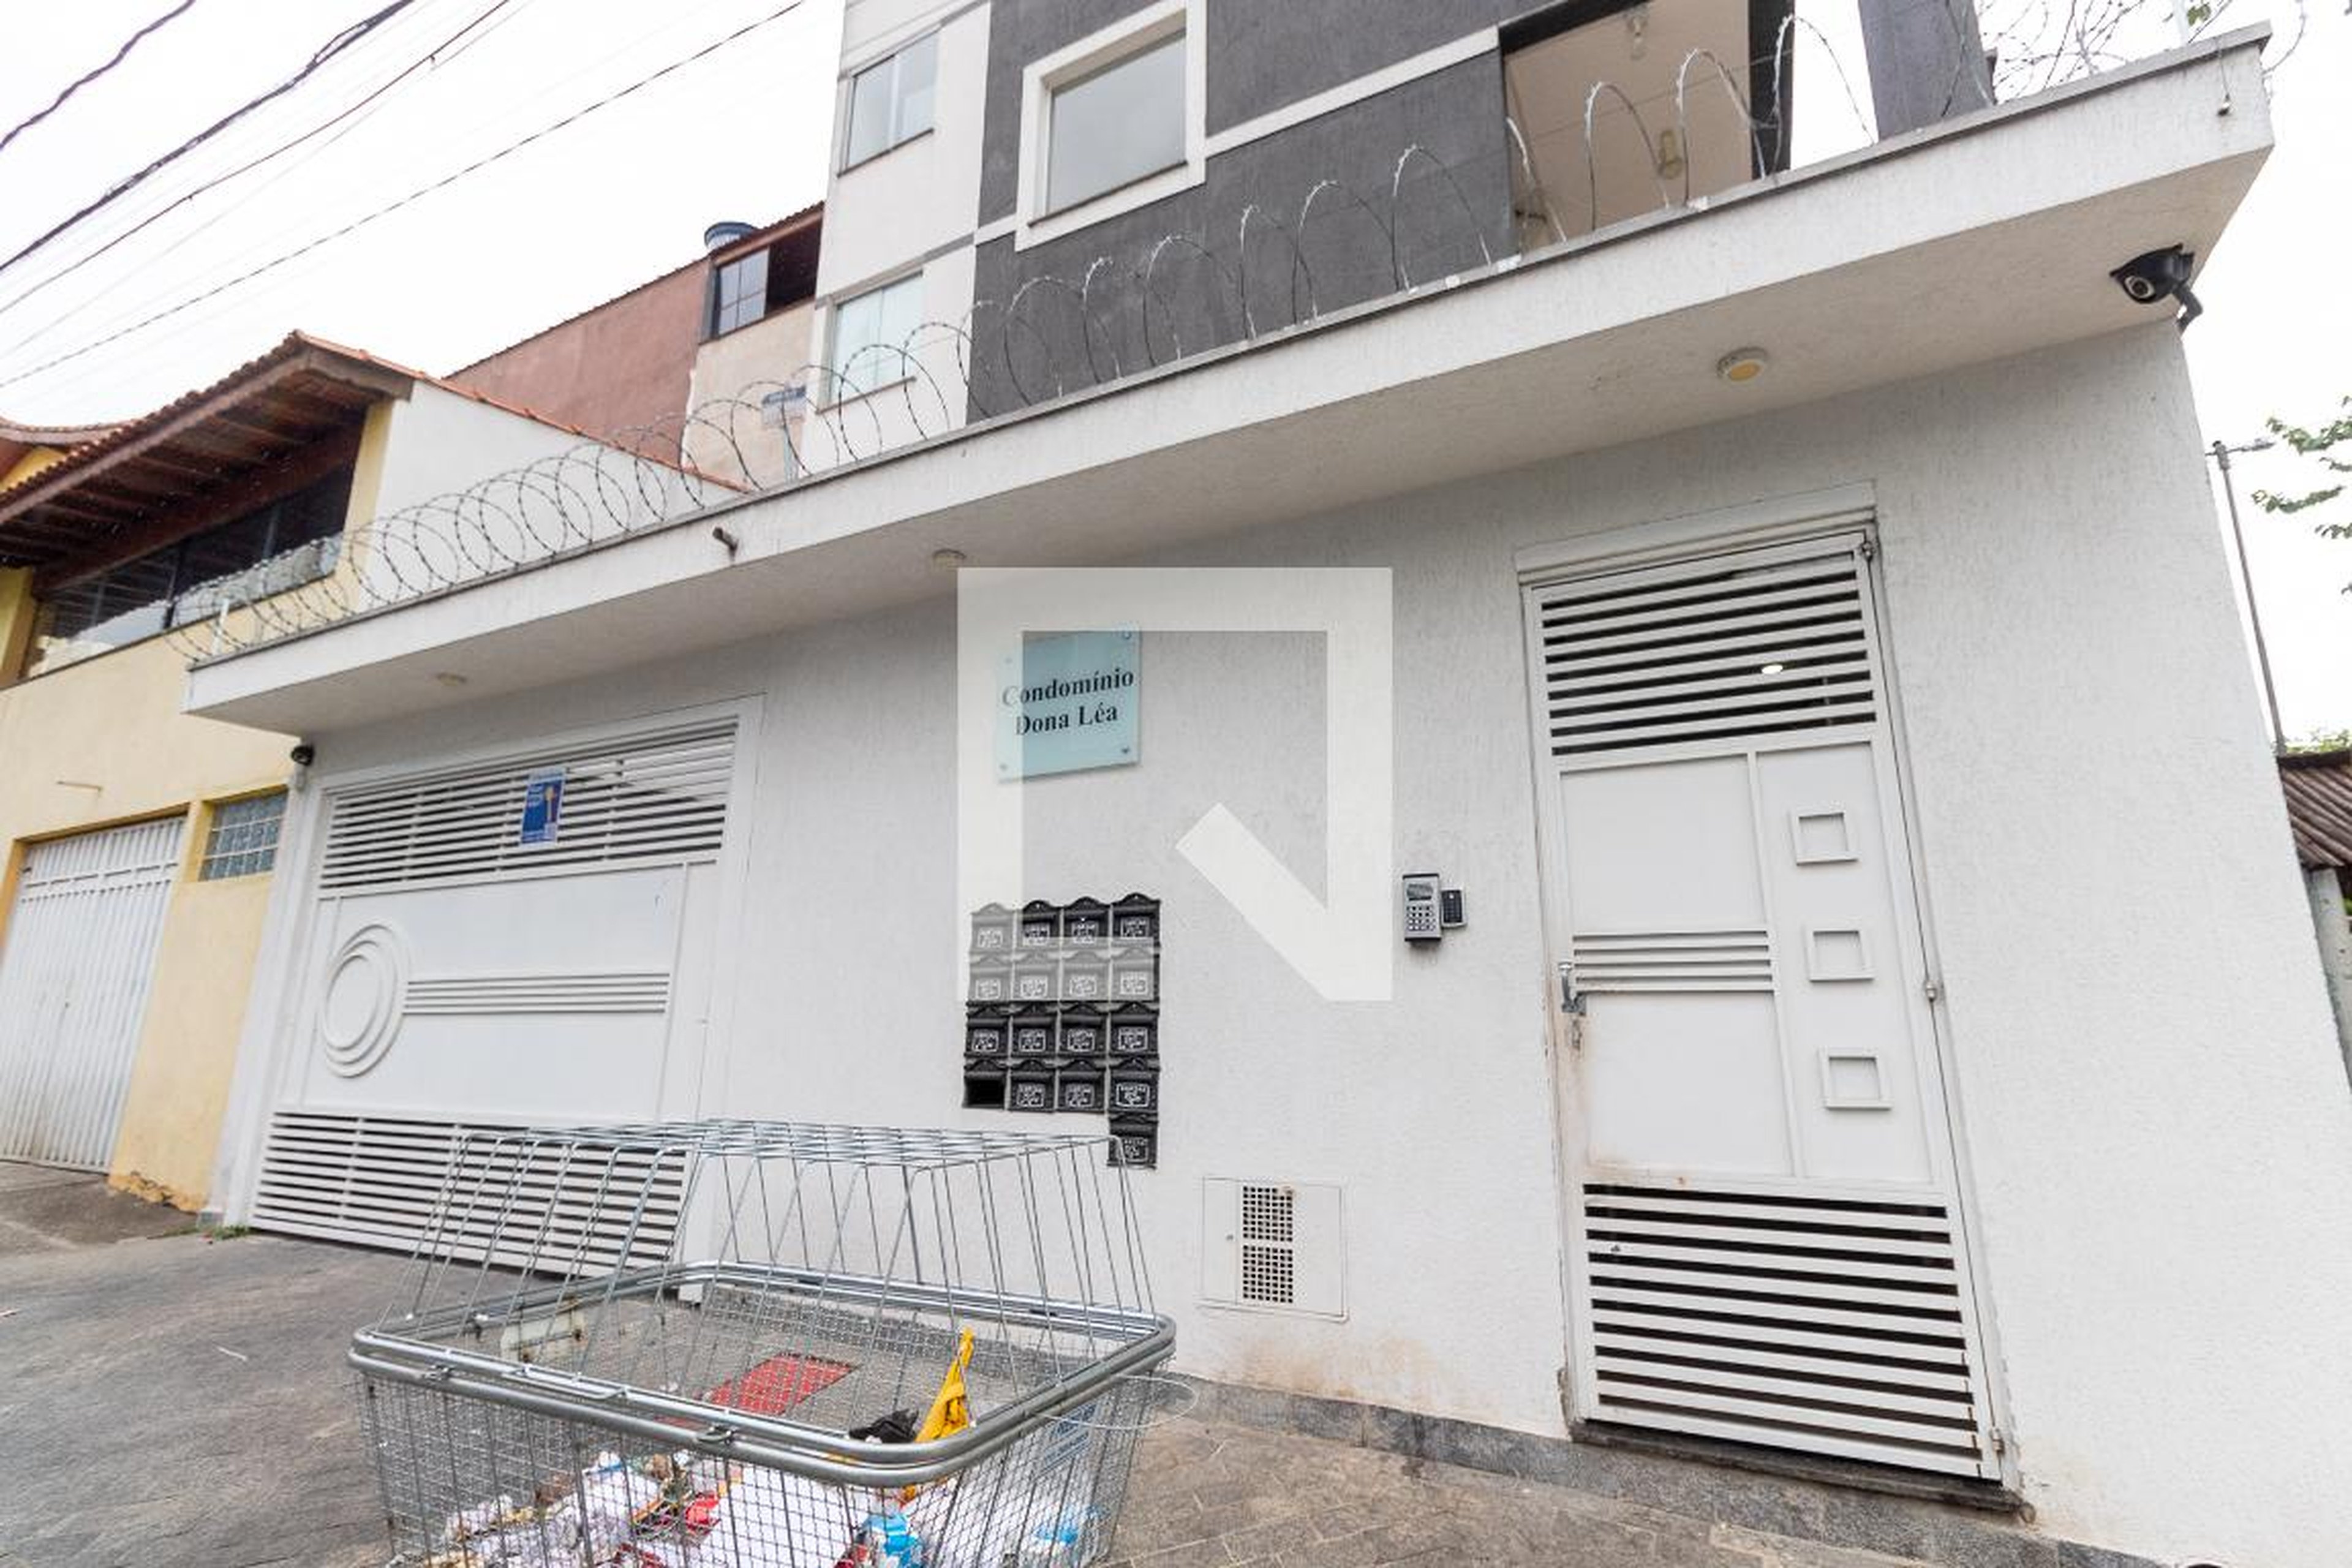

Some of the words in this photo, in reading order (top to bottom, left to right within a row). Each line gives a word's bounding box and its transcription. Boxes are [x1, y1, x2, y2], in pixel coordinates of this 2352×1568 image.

[1002, 667, 1134, 706] Condomínio
[1016, 713, 1069, 735] Dona
[1079, 702, 1118, 727] Léa
